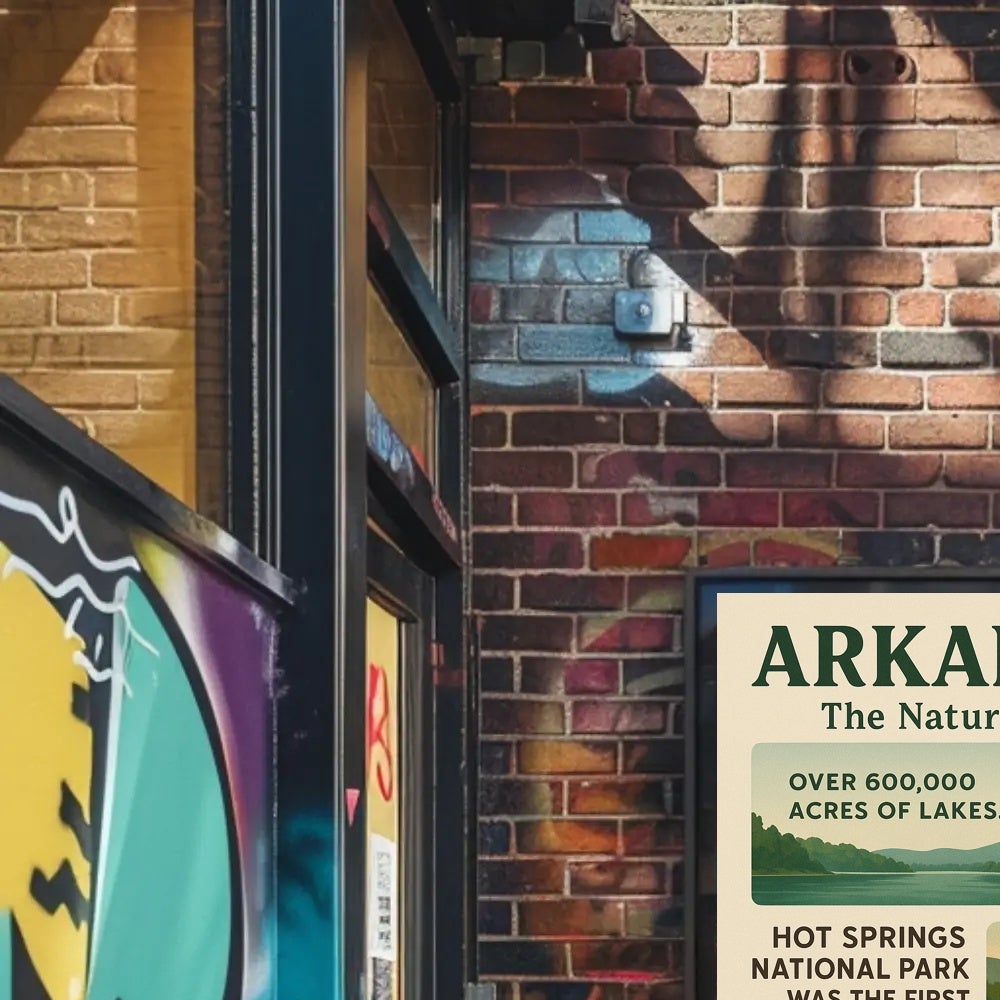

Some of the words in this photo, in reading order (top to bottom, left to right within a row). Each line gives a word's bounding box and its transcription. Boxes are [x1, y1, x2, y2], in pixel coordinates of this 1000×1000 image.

[822, 702, 884, 729] The
[789, 773, 856, 790] OVER
[866, 773, 975, 794] 600,000
[789, 802, 867, 819] ACRES
[878, 802, 910, 819] OF
[774, 926, 831, 948] HOT
[843, 926, 965, 948] SPRINGS
[752, 958, 890, 979] NATIONAL
[900, 958, 969, 979] PARK
